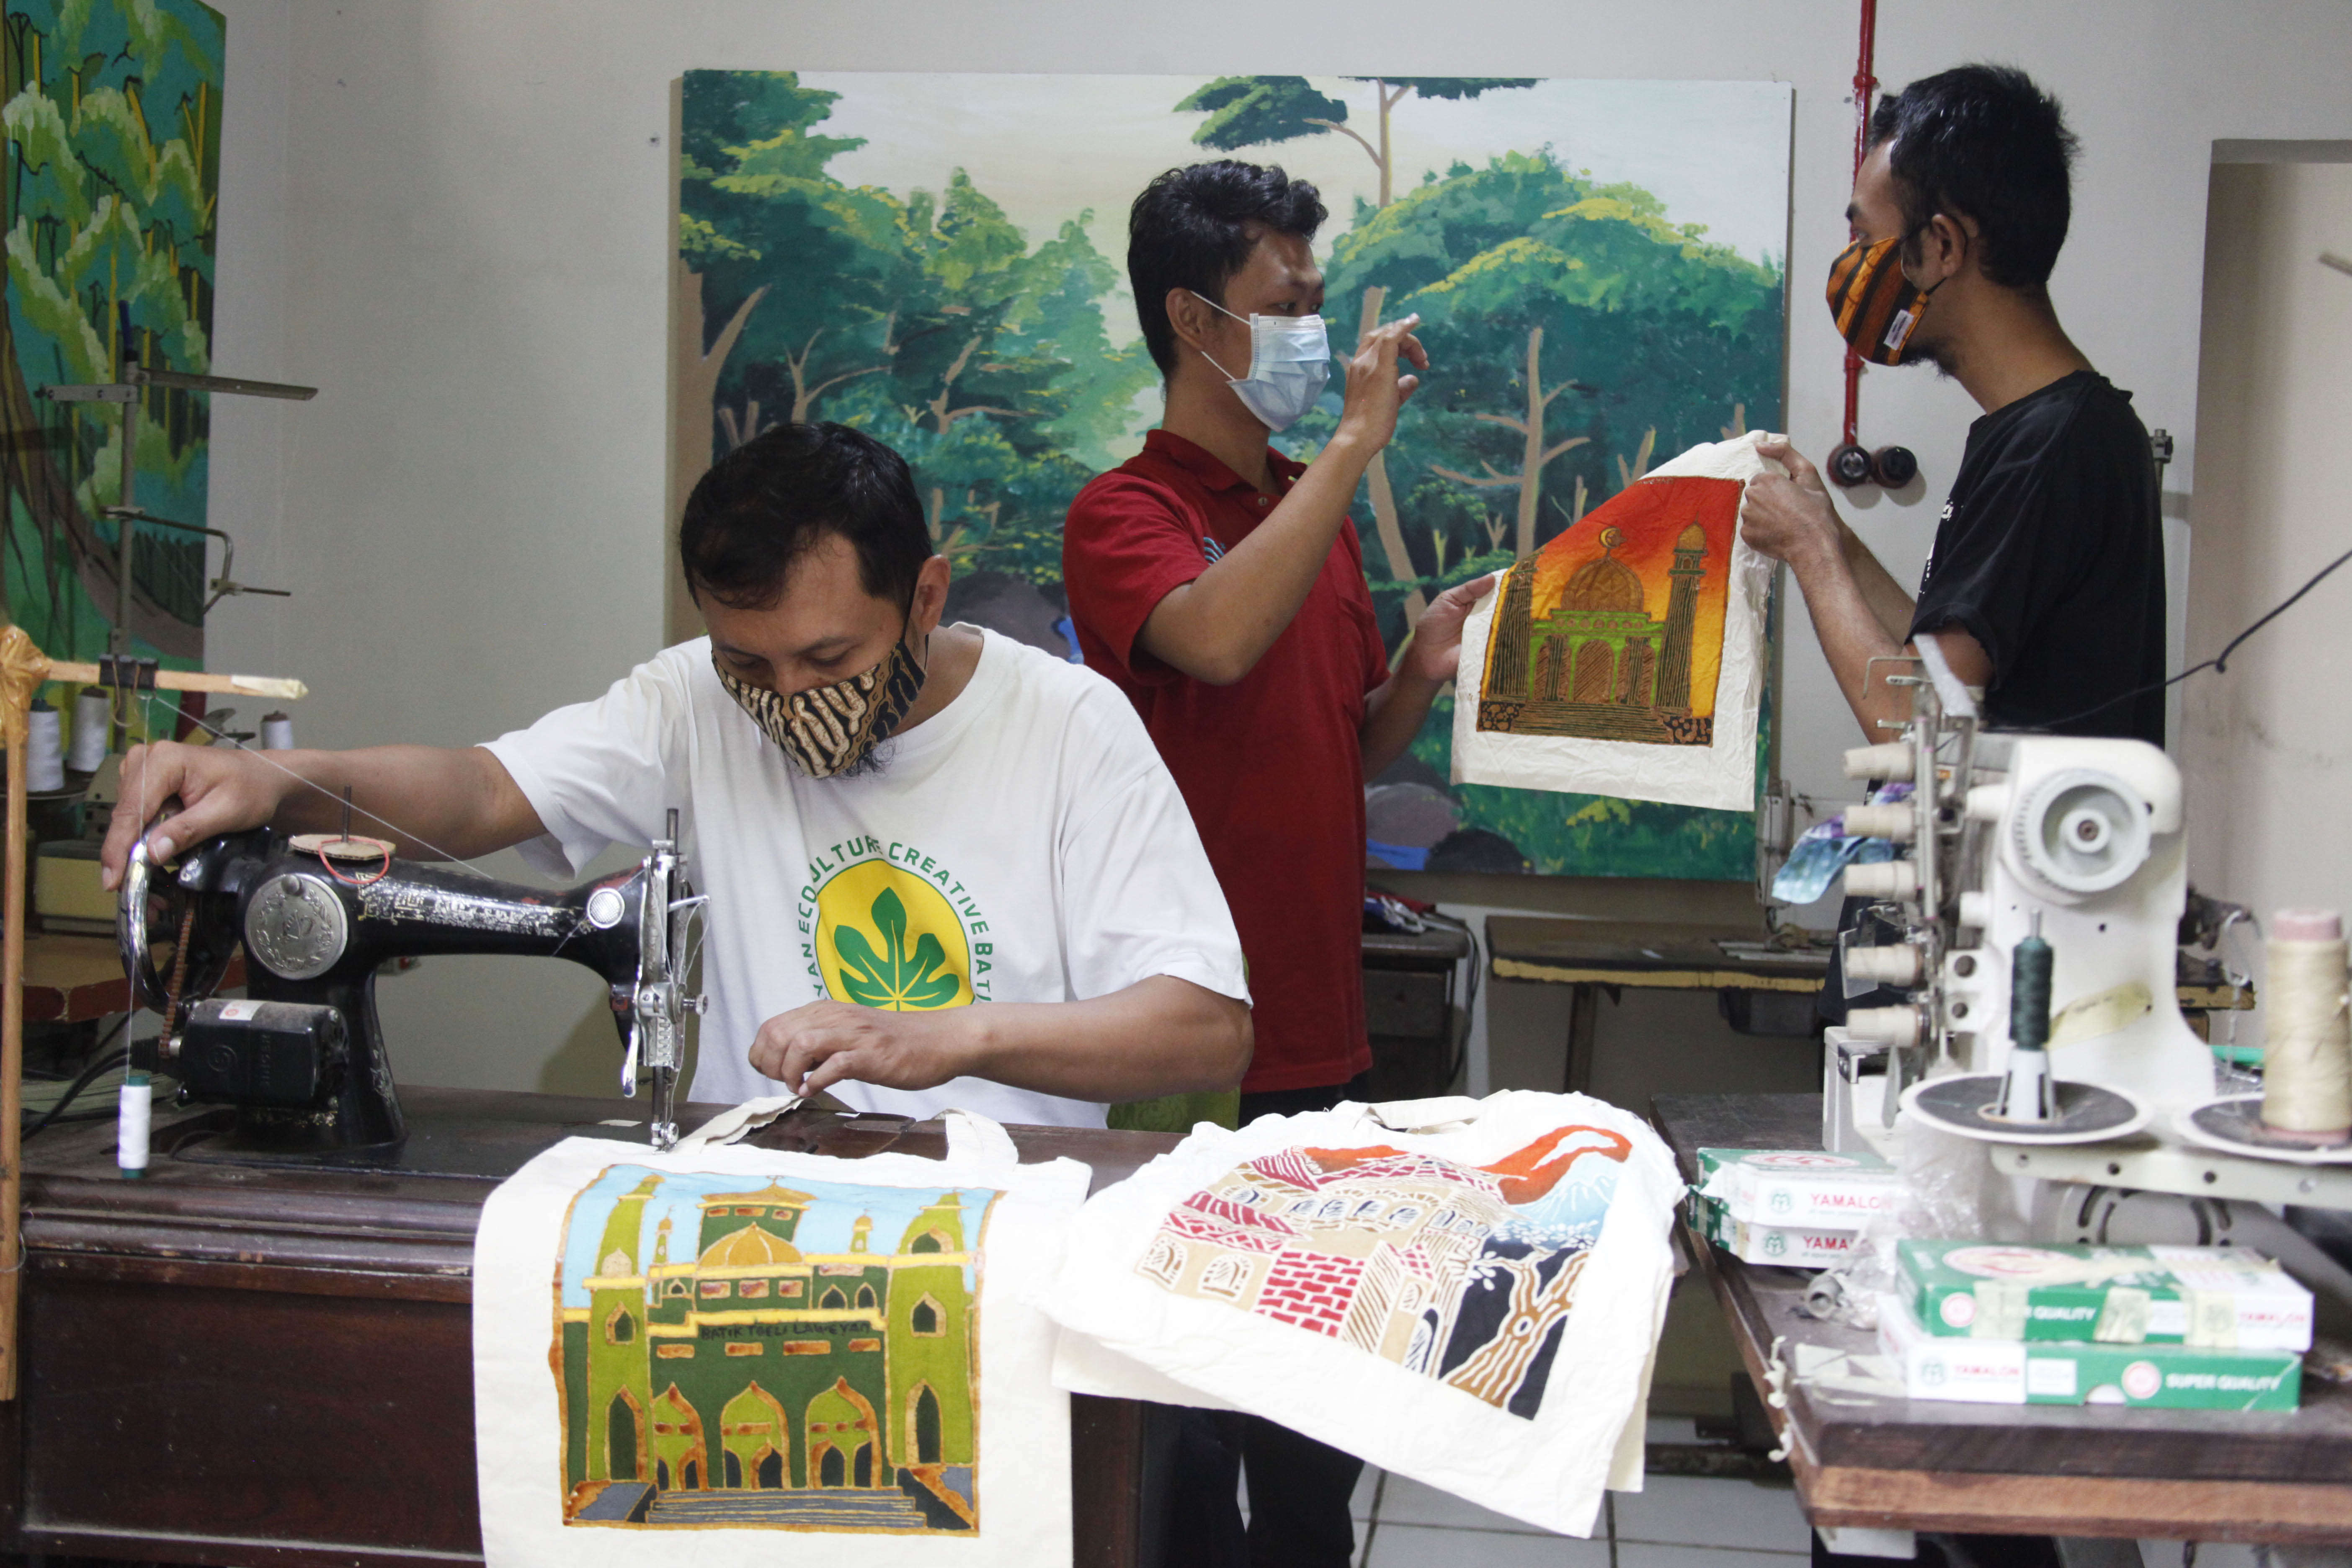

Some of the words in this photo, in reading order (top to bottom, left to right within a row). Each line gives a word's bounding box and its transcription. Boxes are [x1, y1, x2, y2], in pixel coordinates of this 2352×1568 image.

[888, 842, 990, 935] CREATIVE
[975, 943, 993, 1001] BATI
[2166, 1373, 2216, 1389] SUPER
